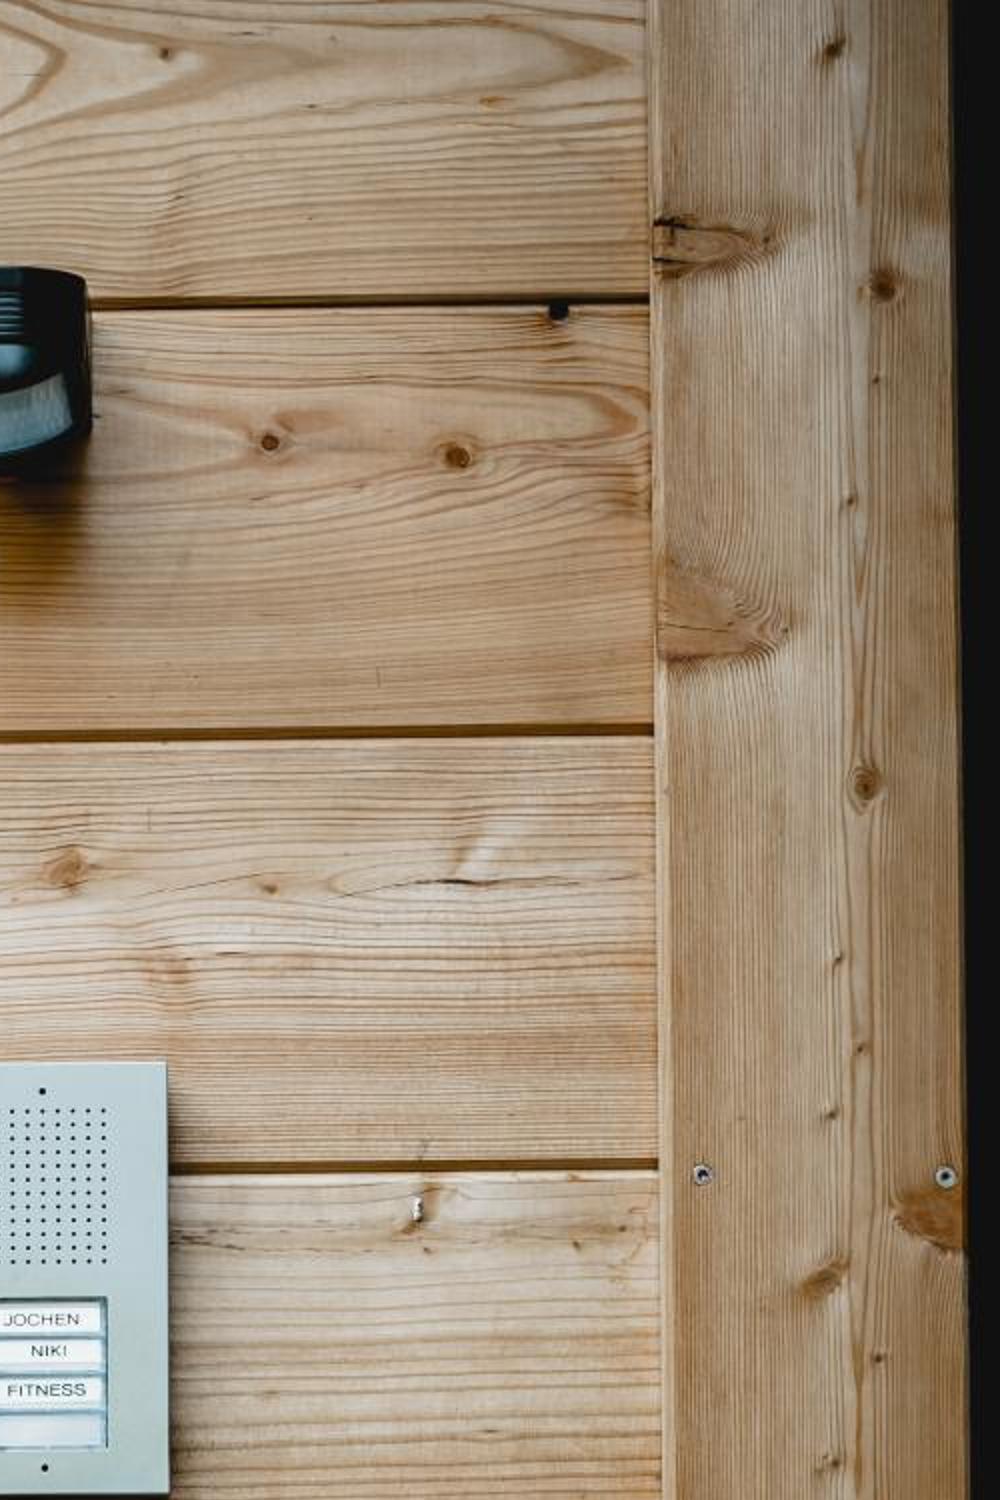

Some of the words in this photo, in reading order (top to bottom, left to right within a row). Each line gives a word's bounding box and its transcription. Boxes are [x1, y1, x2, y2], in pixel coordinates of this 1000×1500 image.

[3, 1313, 80, 1327] JOCHEN
[31, 1345, 67, 1357] NIKI
[7, 1383, 87, 1397] FITNESS
